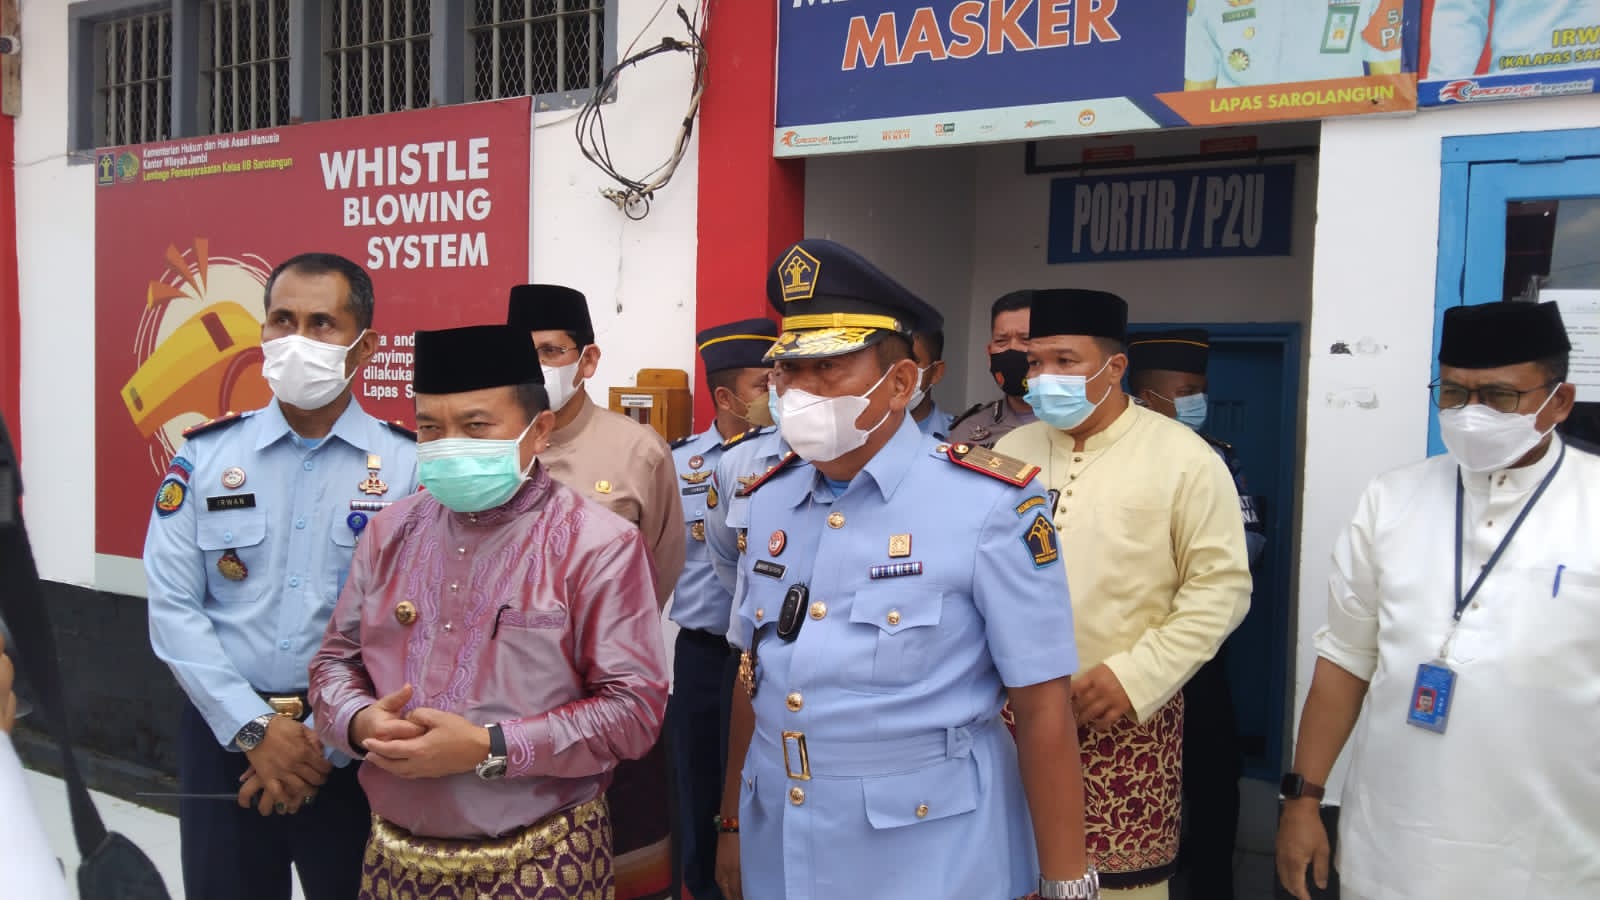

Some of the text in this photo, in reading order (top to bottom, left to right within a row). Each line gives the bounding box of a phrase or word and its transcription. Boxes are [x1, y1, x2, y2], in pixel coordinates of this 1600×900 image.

[841, 0, 1121, 71] MASKER
[1209, 84, 1394, 114] LAPAS SAROLANGUN
[181, 142, 203, 154] Hukum
[204, 140, 216, 152] dan
[217, 138, 230, 149] Hak
[251, 133, 280, 145] Manusia
[143, 152, 208, 169] Kantor Wilayah Jambi
[253, 157, 293, 170] Sarolangun
[319, 136, 490, 191] WHISTLE
[343, 187, 492, 227] BLOWING
[1072, 173, 1265, 254] PORTIR / P2U
[366, 232, 489, 270] SYSTEM
[363, 366, 415, 381] dilakuka
[363, 382, 398, 400] Lapas
[217, 497, 244, 506] IRWAN
